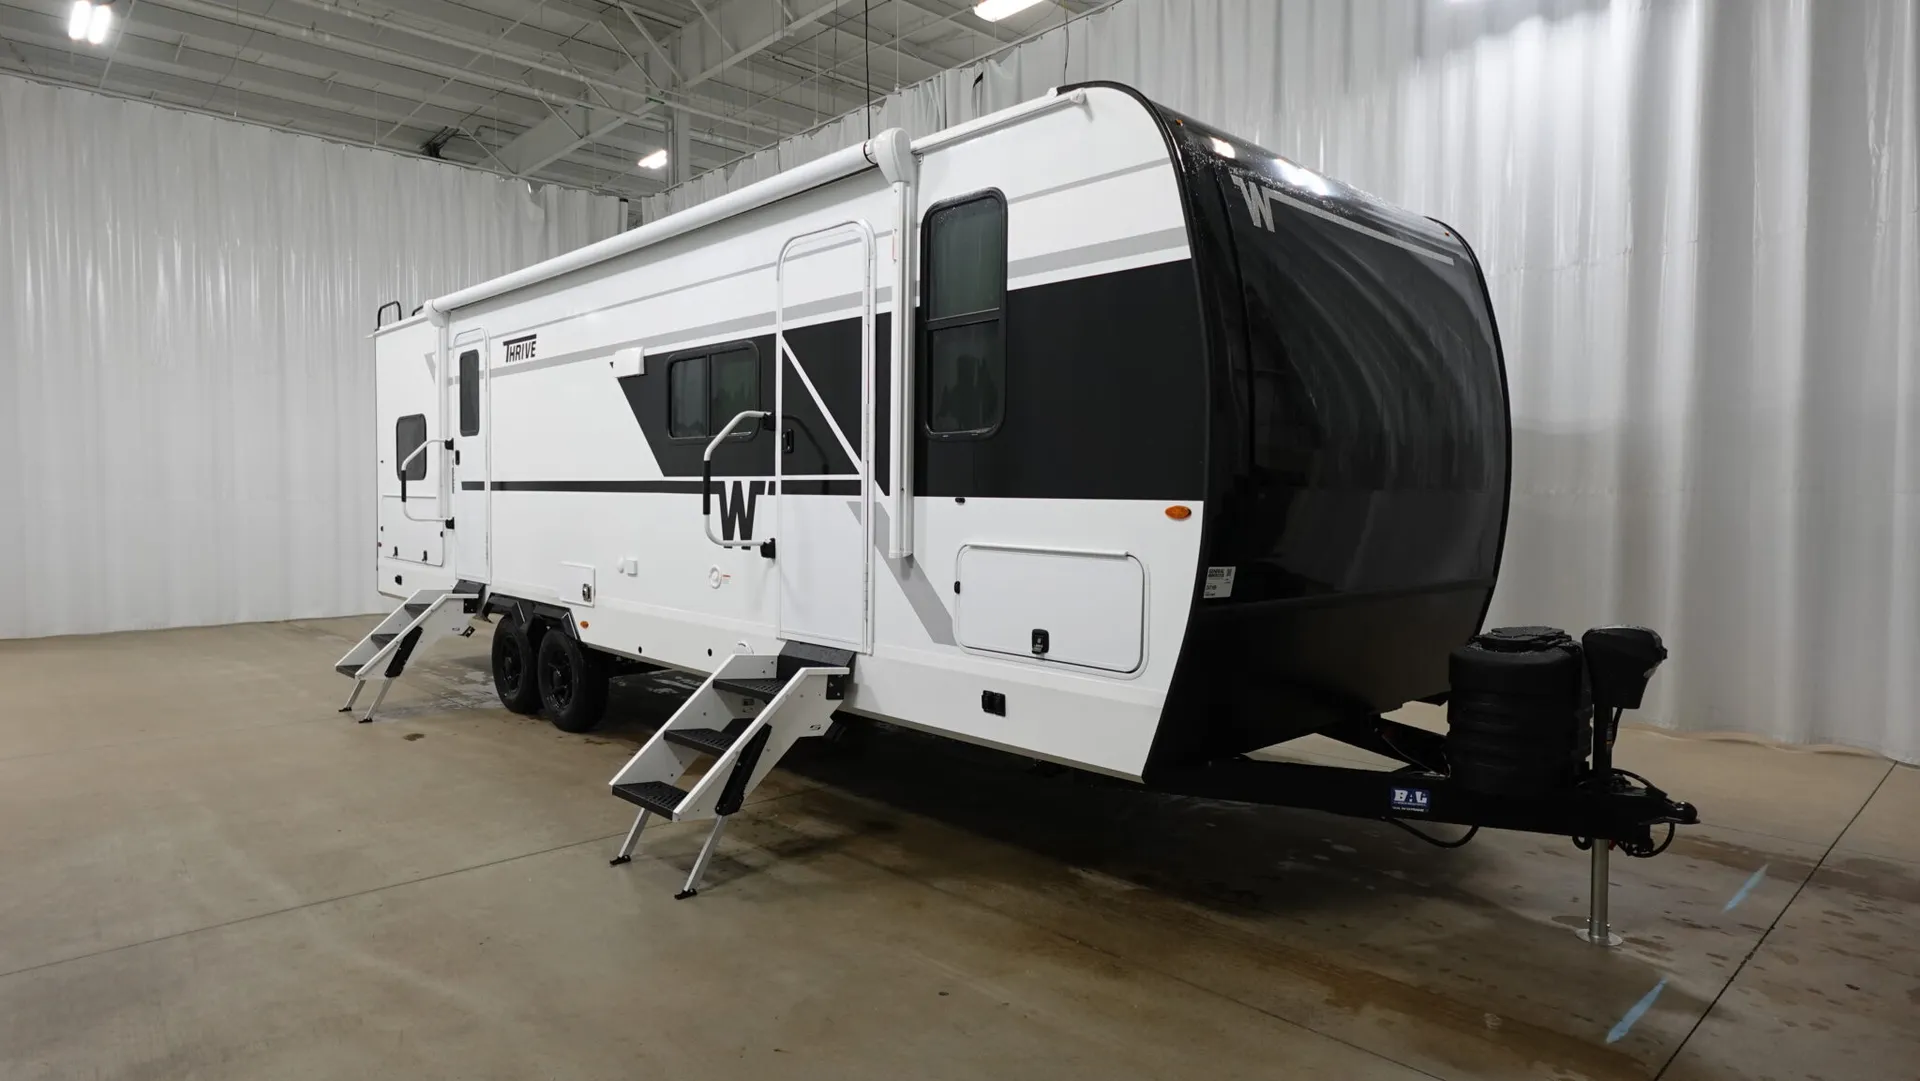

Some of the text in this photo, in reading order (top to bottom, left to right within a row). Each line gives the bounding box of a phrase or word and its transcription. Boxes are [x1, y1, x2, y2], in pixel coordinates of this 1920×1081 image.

[1230, 173, 1276, 233] W
[502, 333, 537, 363] THRIVE
[718, 480, 766, 550] W
